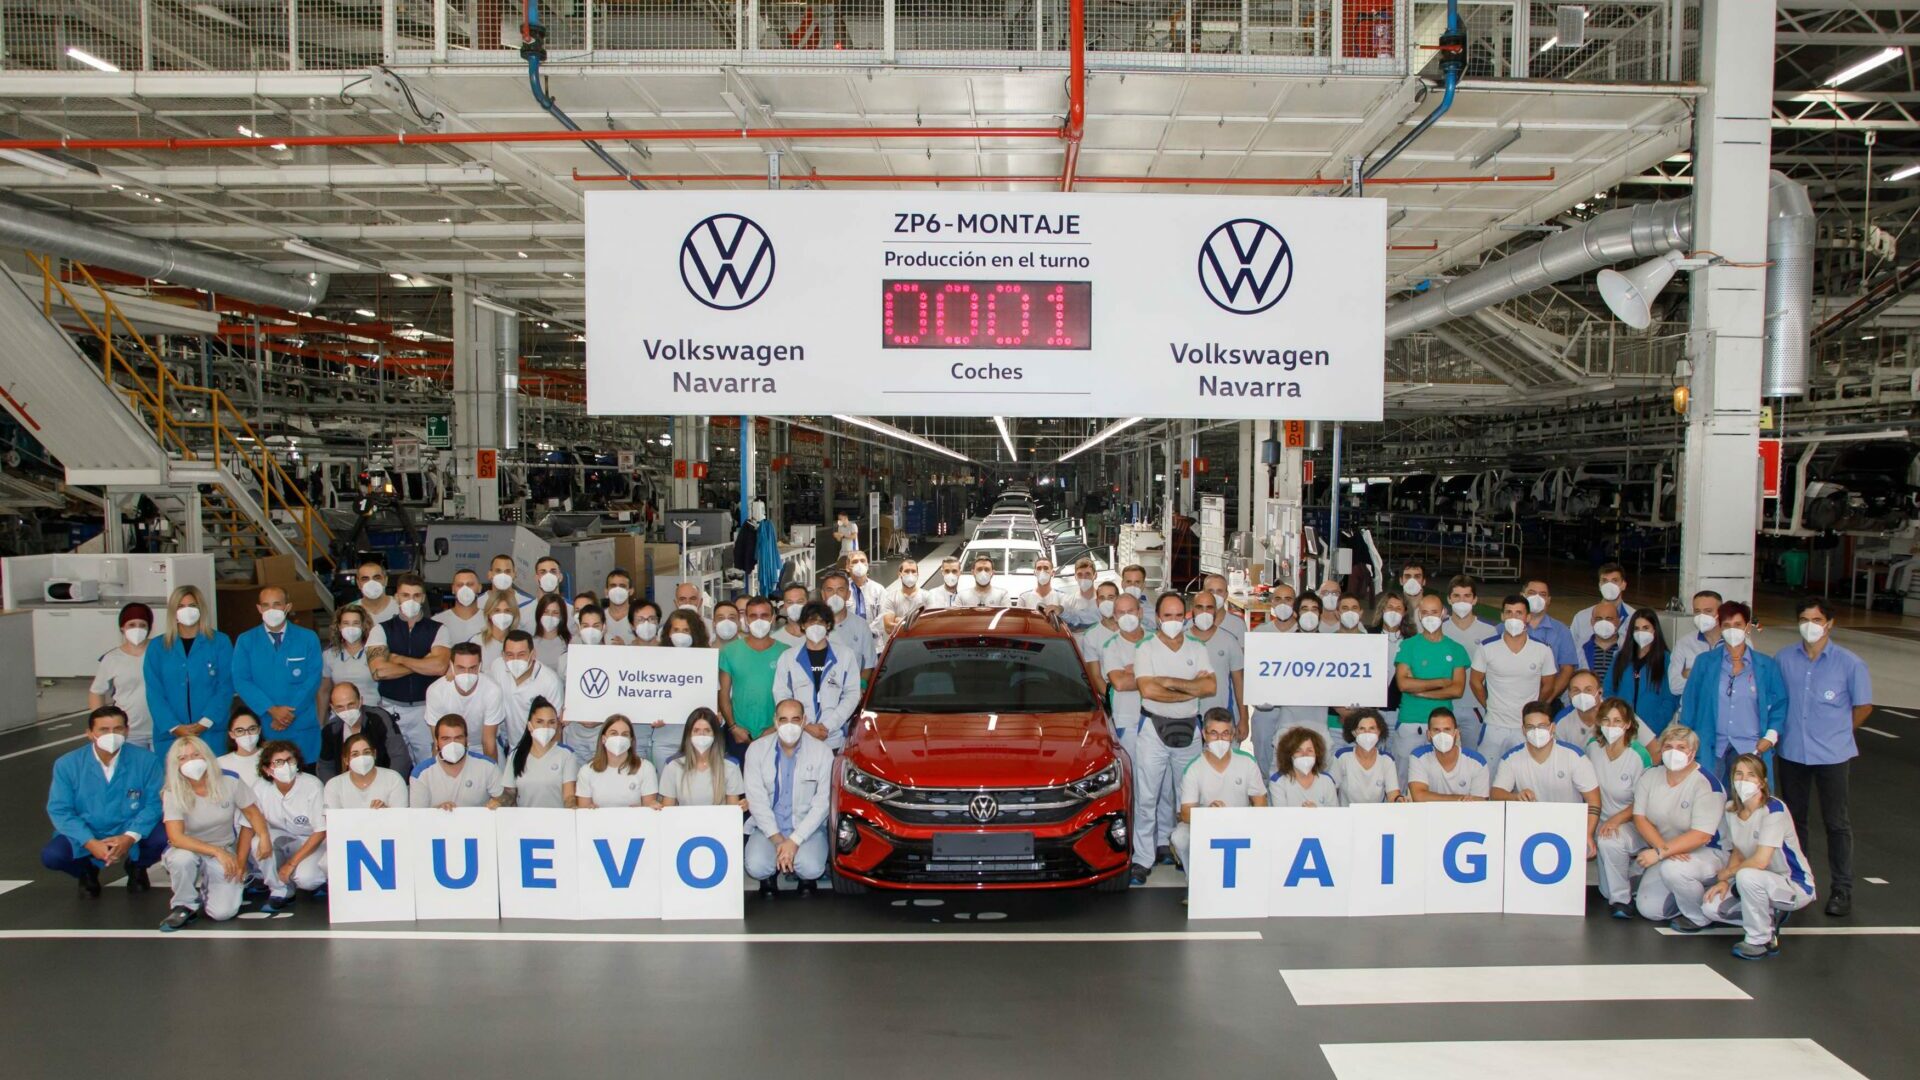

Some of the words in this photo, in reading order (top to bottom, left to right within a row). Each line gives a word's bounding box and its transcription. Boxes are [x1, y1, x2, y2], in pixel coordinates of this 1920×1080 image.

[894, 213, 1080, 235] ZP6-MONTAJE
[884, 250, 987, 267] Producción
[991, 255, 1014, 268] en
[1018, 251, 1035, 268] el
[1039, 253, 1090, 269] turno
[885, 283, 1072, 345] 0001
[643, 338, 805, 367] Volkswagen
[1169, 342, 1330, 371] Volkswagen
[951, 362, 1023, 380] Coches
[673, 371, 777, 393] Navarra
[1199, 375, 1302, 398] Navarra
[1290, 420, 1299, 433] B
[1289, 433, 1302, 446] 61
[482, 452, 491, 465] C
[480, 465, 493, 477] 61
[618, 670, 703, 686] Volkswagen
[1259, 661, 1372, 678] 27/09/2021
[618, 685, 672, 698] Navarra
[346, 836, 729, 892] NUEVO
[1209, 831, 1573, 889] TAIGO
